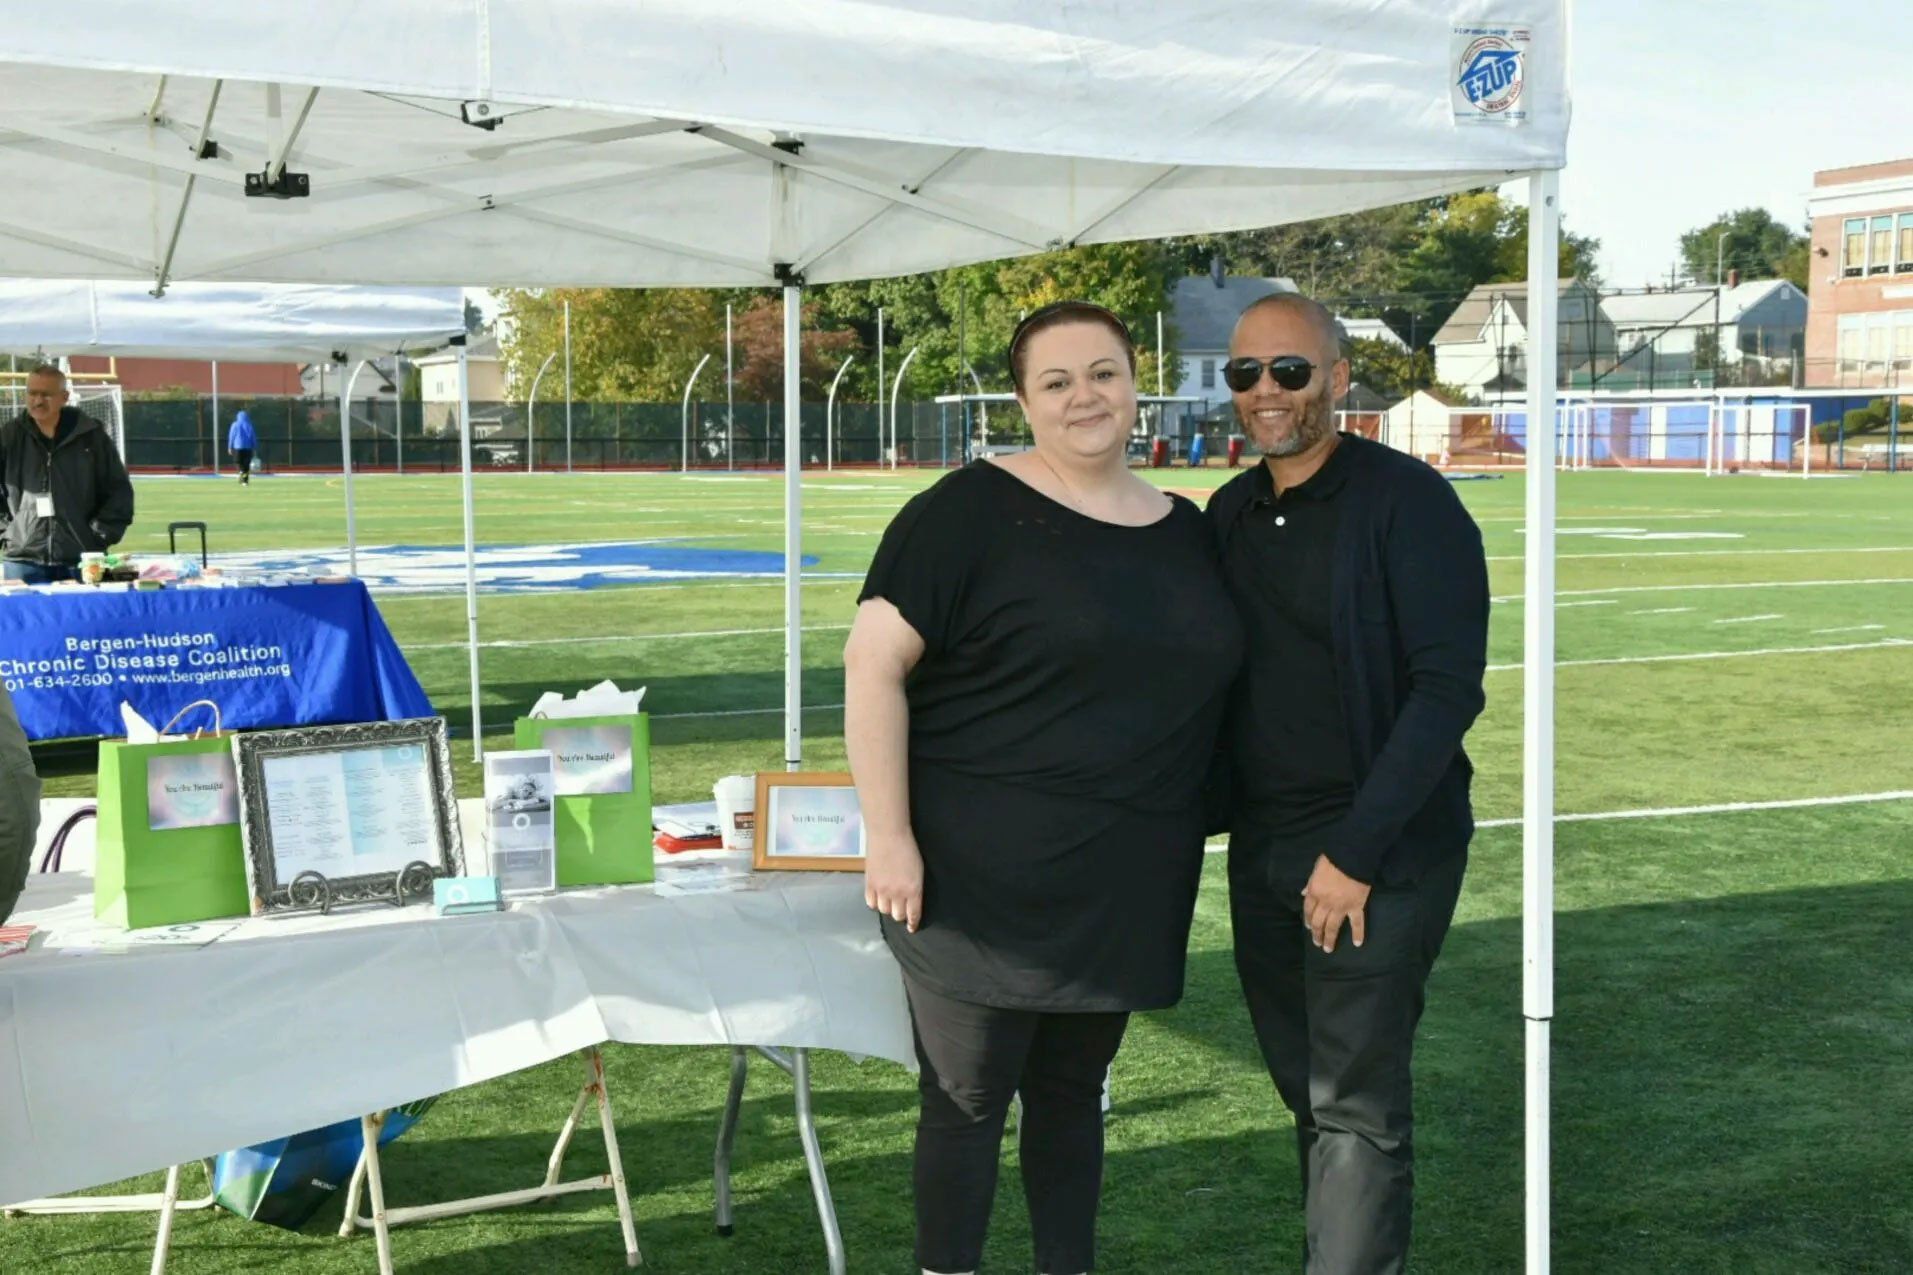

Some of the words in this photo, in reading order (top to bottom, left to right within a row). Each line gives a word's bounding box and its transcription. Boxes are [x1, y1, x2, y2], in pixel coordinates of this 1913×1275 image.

[65, 632, 215, 654] Bergen-Hudson
[0, 655, 86, 676] Chronic
[94, 653, 180, 670] Disease
[188, 644, 282, 666] Coalition
[132, 663, 291, 685] www.bergenhealth.org
